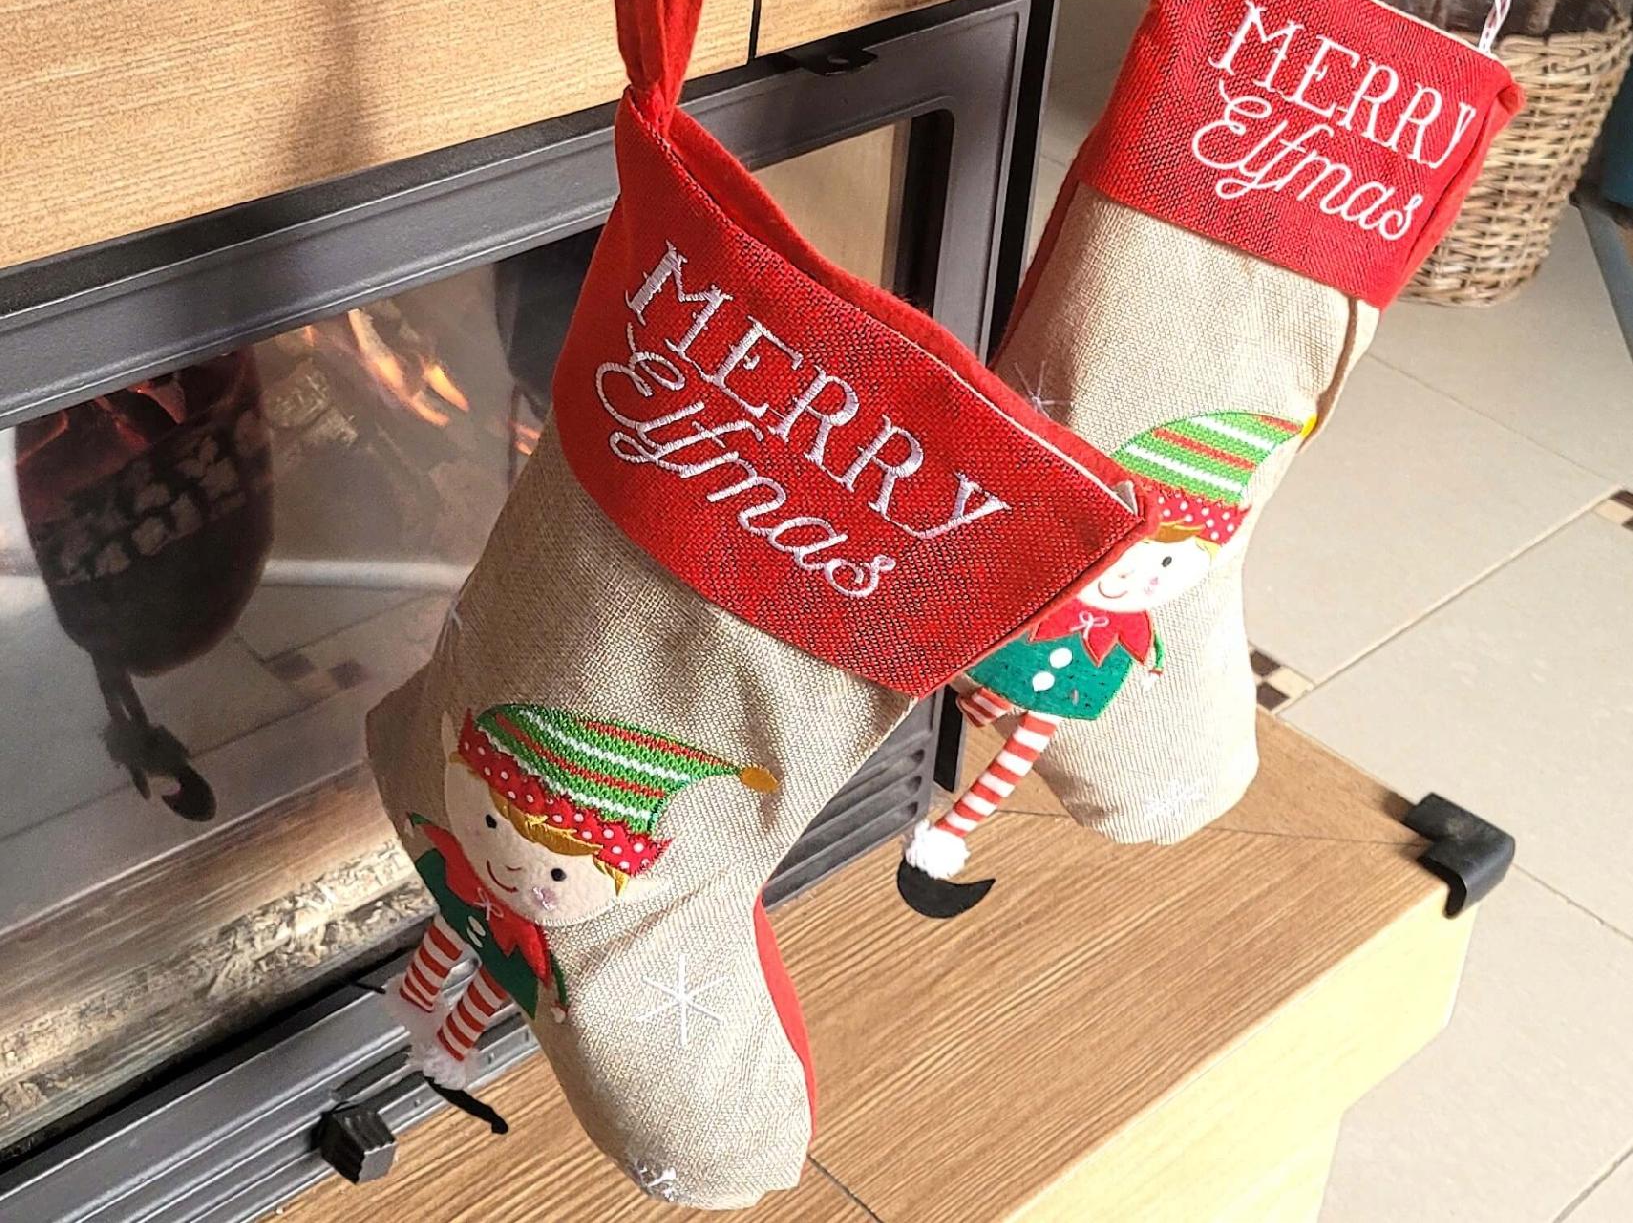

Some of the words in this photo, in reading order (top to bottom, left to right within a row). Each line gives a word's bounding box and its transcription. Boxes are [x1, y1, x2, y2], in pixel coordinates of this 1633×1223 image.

[1191, 79, 1424, 241] Elfmas
[1208, 0, 1477, 169] MERRY
[595, 322, 897, 598] Elfmas
[624, 239, 1012, 540] MERRY
